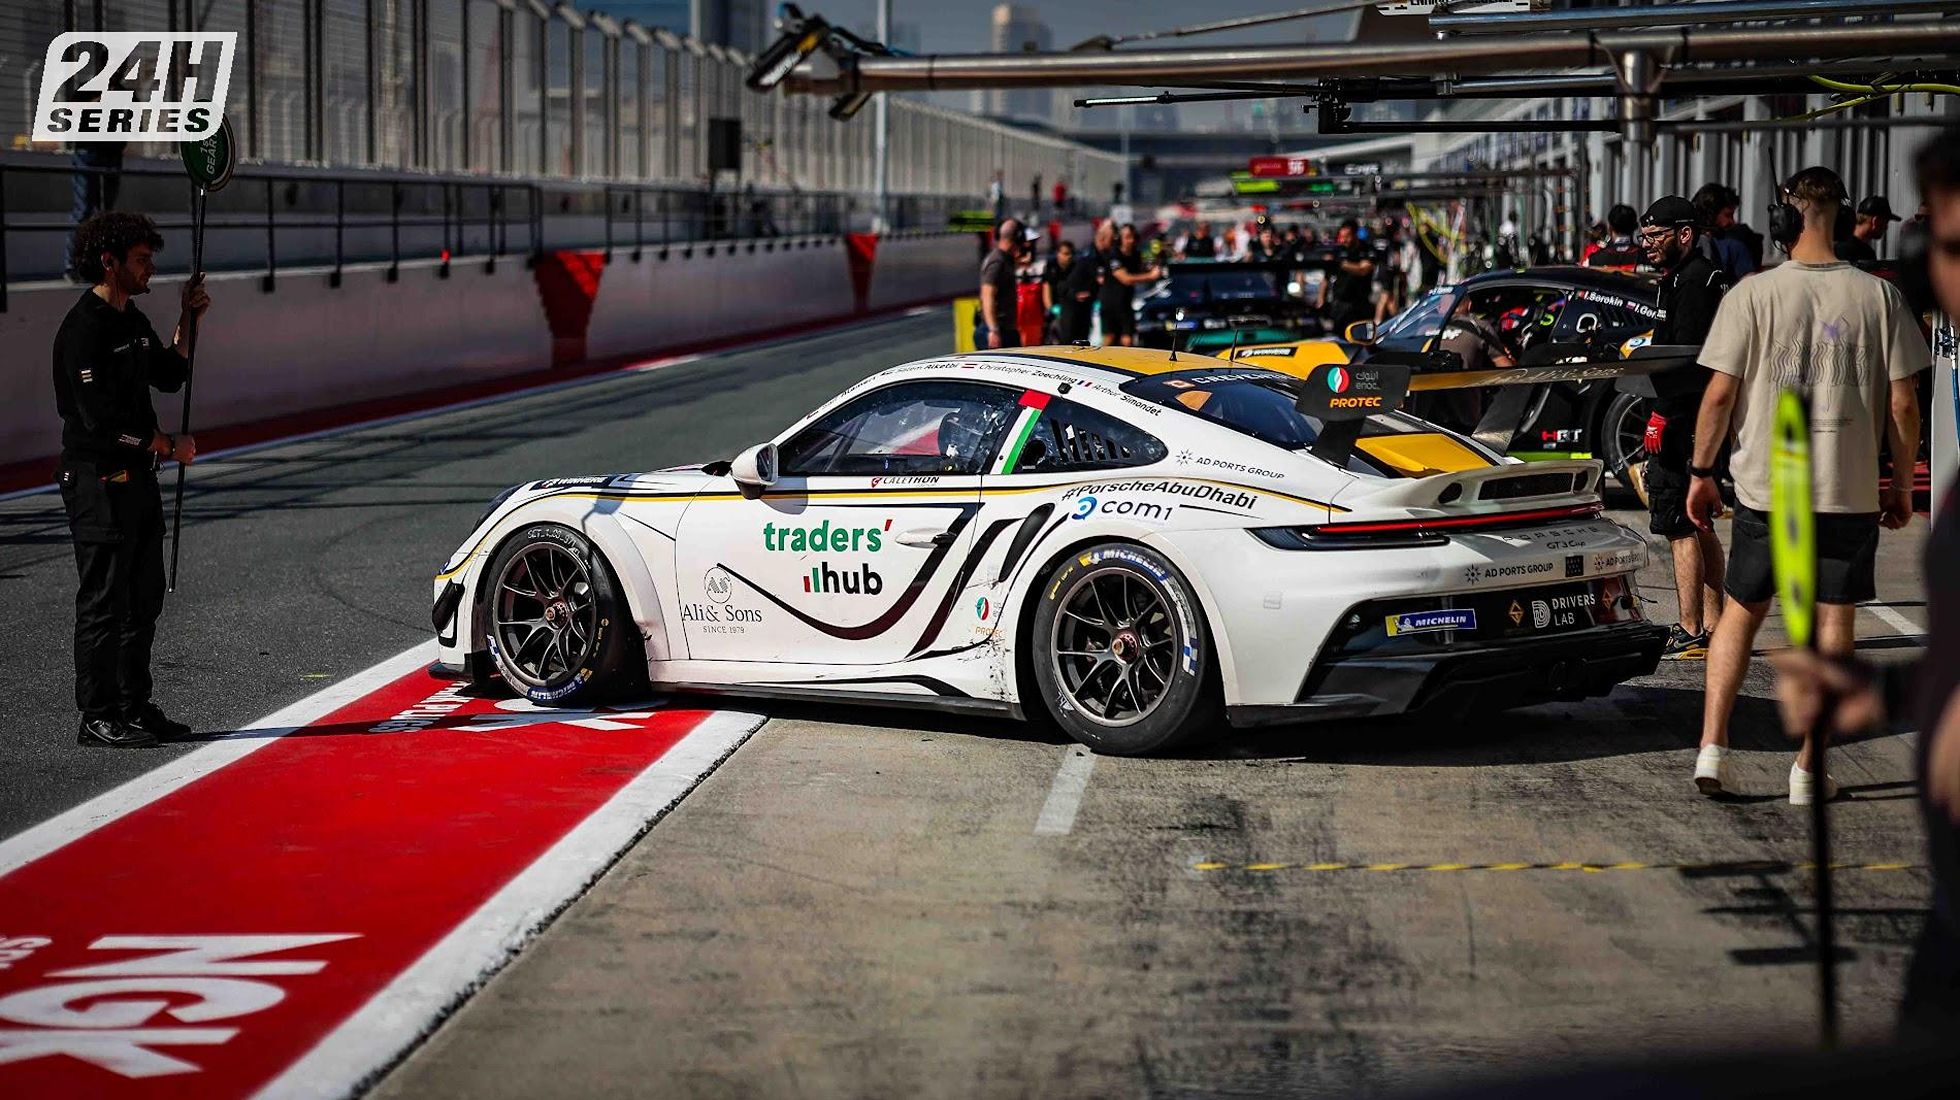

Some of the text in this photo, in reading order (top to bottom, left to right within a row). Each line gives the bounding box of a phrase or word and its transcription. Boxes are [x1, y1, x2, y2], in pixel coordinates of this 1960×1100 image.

[979, 363, 1031, 375] Christopher
[1092, 383, 1162, 416] Arthur Simondet
[1329, 396, 1383, 408] PROTEC
[1196, 456, 1285, 480] AD PORTS GROUP
[1061, 480, 1258, 510] #PorscheAbuDhabi
[822, 561, 883, 595] hub
[1484, 567, 1498, 578] AD
[1499, 564, 1526, 577] PORTS
[1527, 562, 1554, 574] GROUP
[1551, 593, 1596, 610] DRIVERS
[725, 605, 763, 623] Sons
[1415, 615, 1467, 627] MICHELIN
[1554, 612, 1575, 626] LAB
[703, 626, 727, 634] SINCE
[0, 932, 366, 1079] NGK
